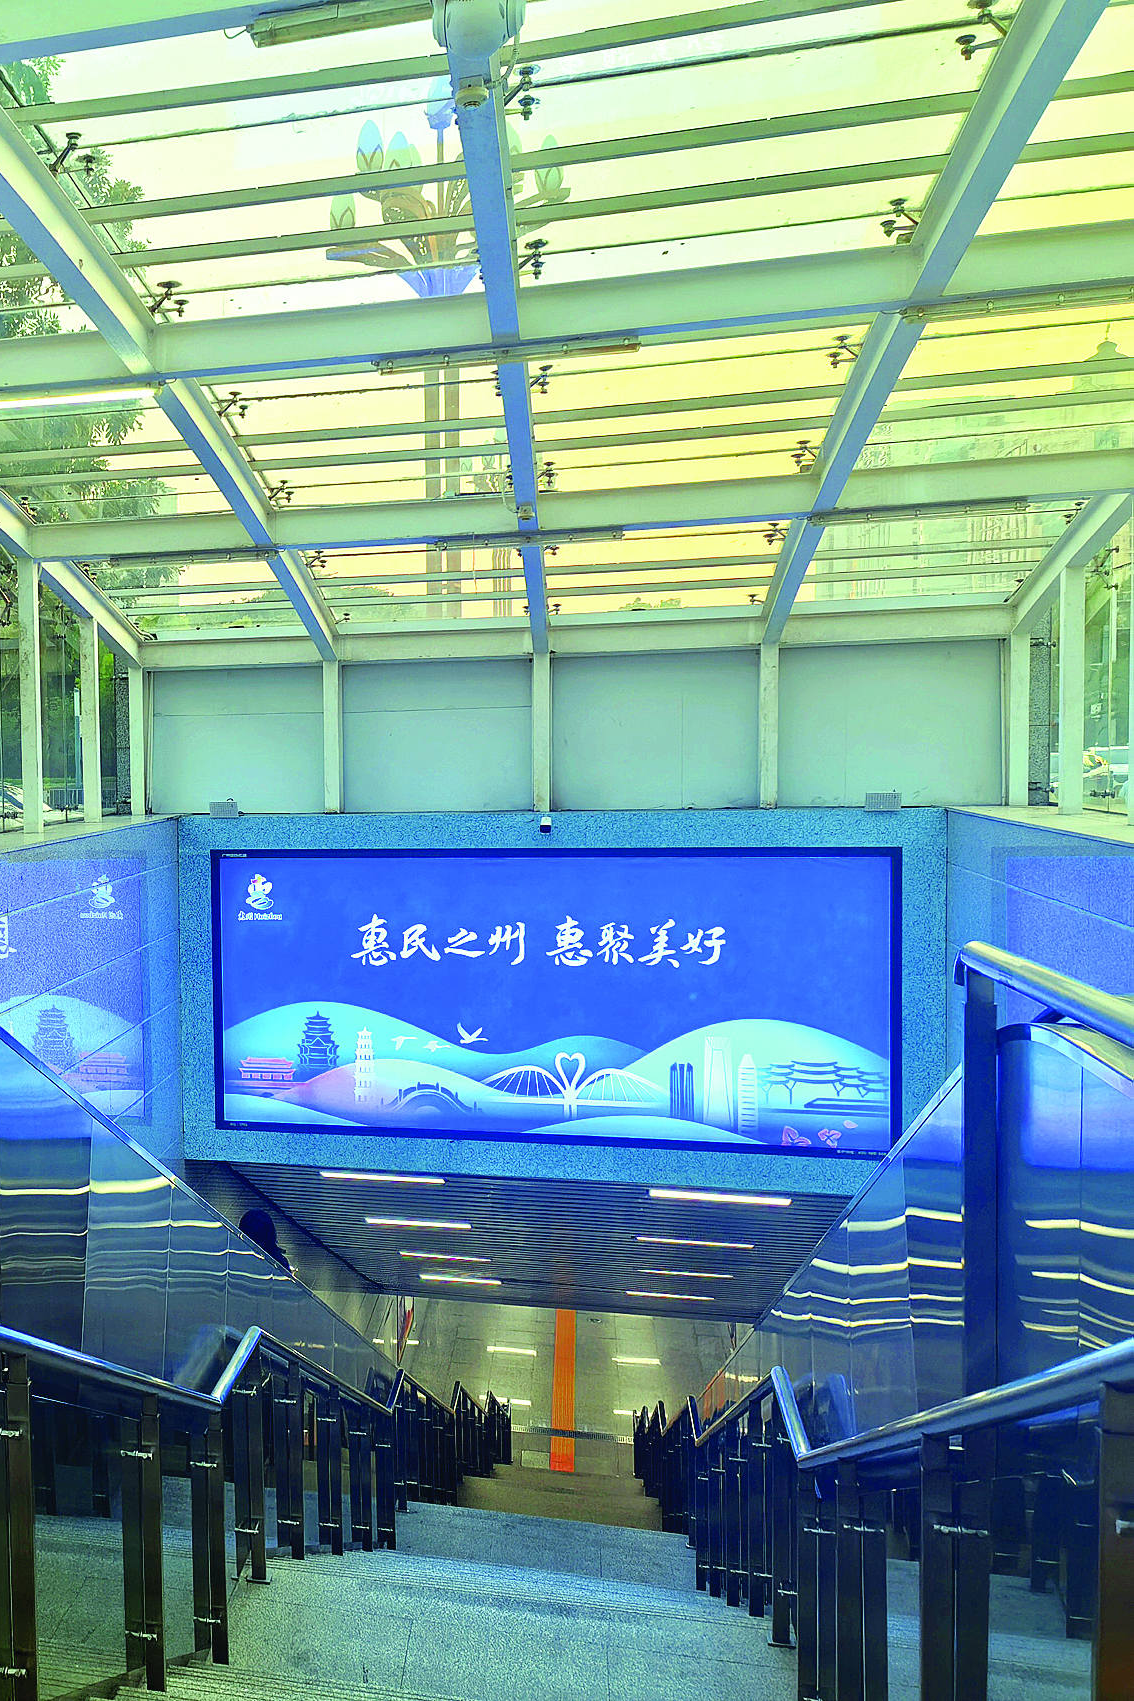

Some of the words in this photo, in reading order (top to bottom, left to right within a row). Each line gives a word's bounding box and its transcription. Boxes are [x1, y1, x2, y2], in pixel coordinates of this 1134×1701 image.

[350, 913, 526, 967] 惠民之州
[546, 914, 727, 968] 惠聚美好
